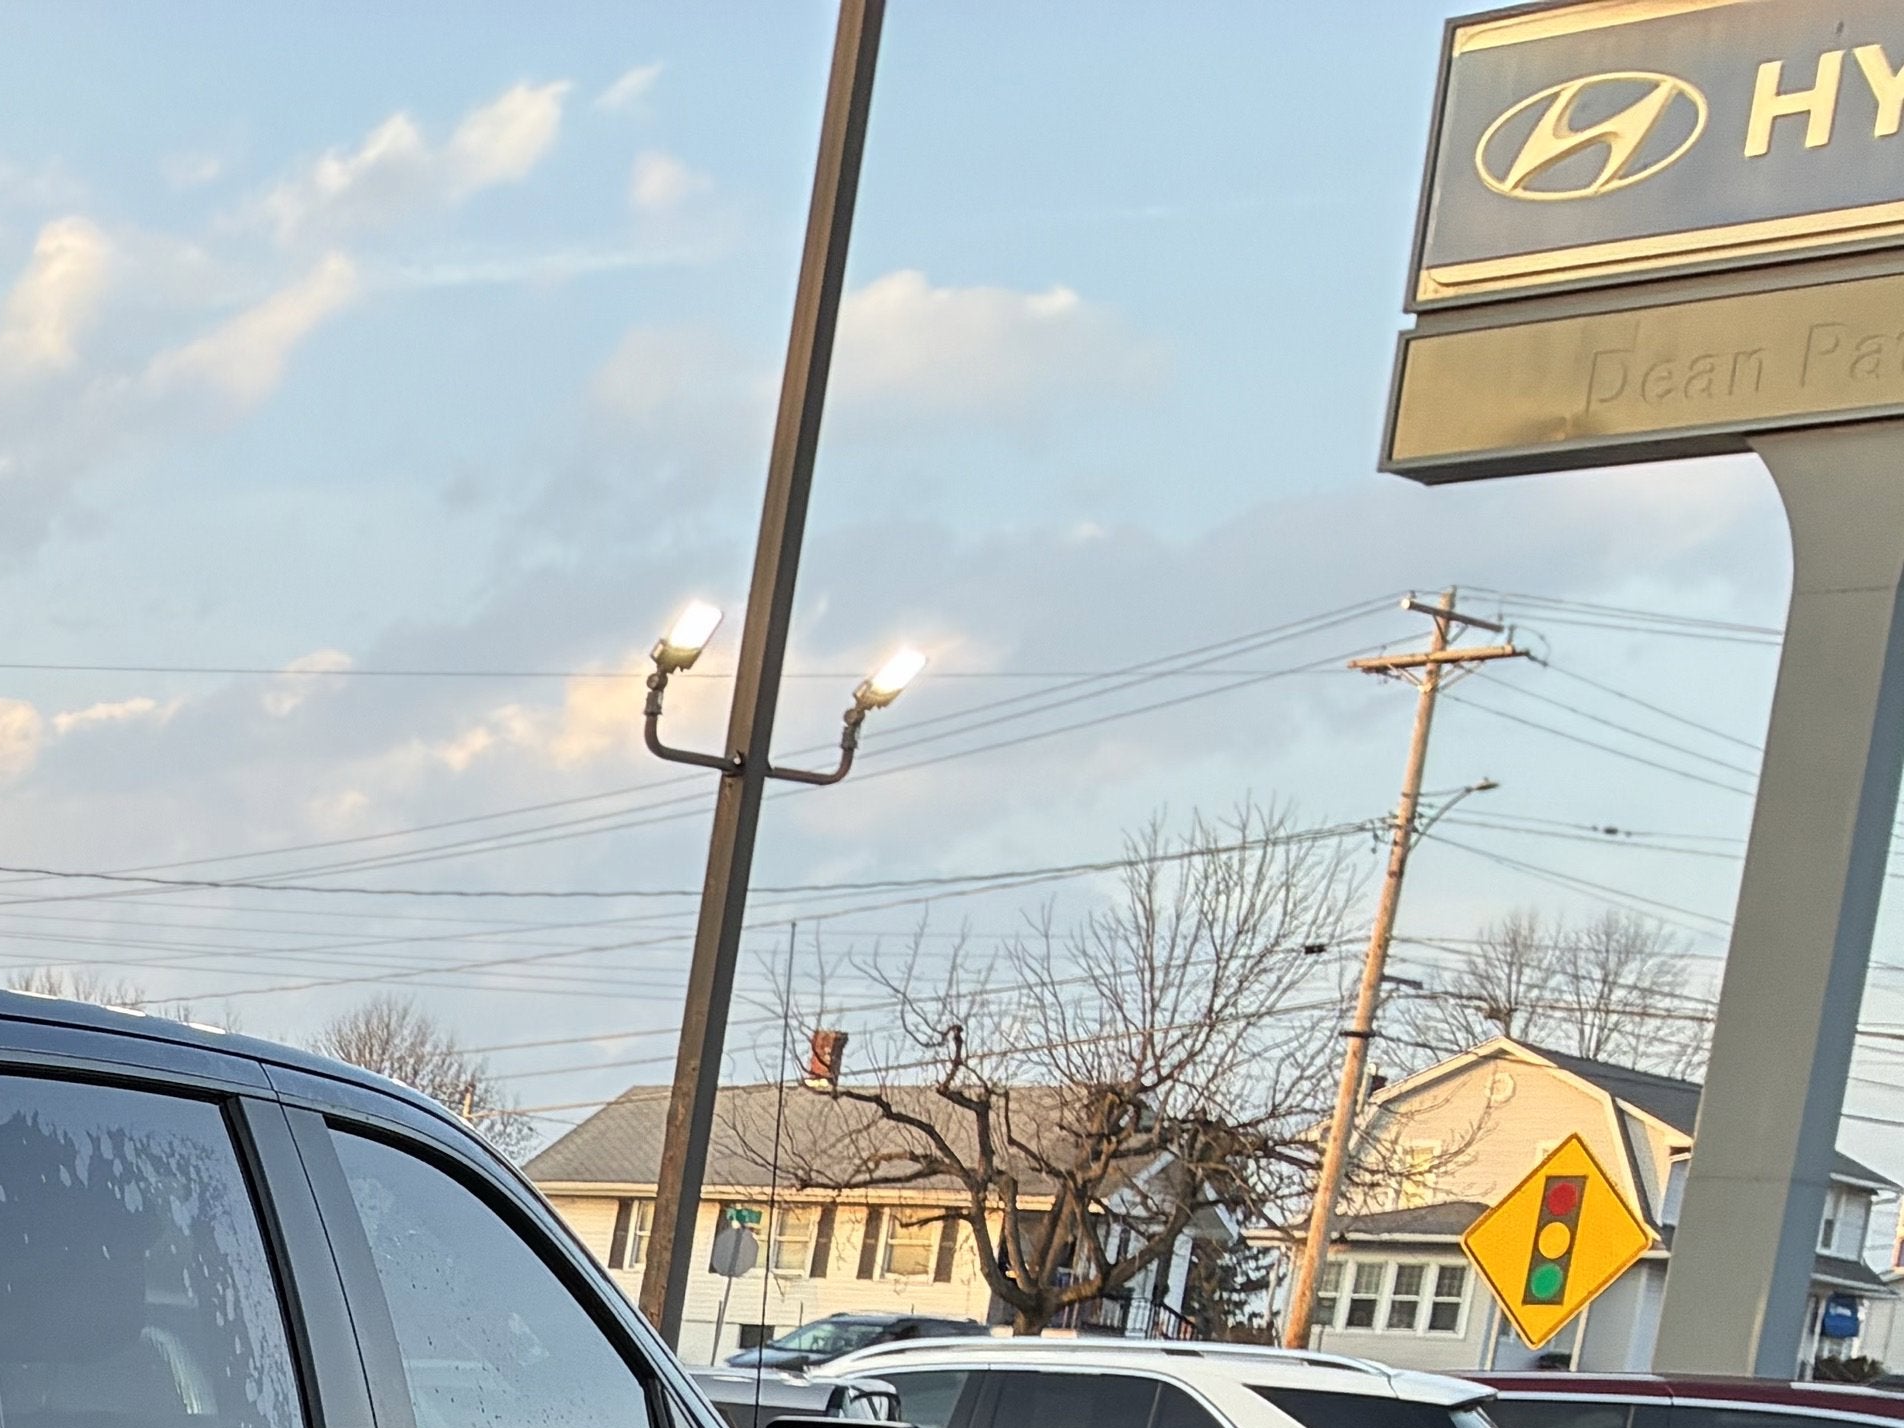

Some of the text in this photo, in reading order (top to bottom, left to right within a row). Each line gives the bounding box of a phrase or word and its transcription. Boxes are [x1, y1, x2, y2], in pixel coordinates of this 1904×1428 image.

[1743, 44, 1904, 158] HY
[1585, 322, 1904, 414] Dean Pa
